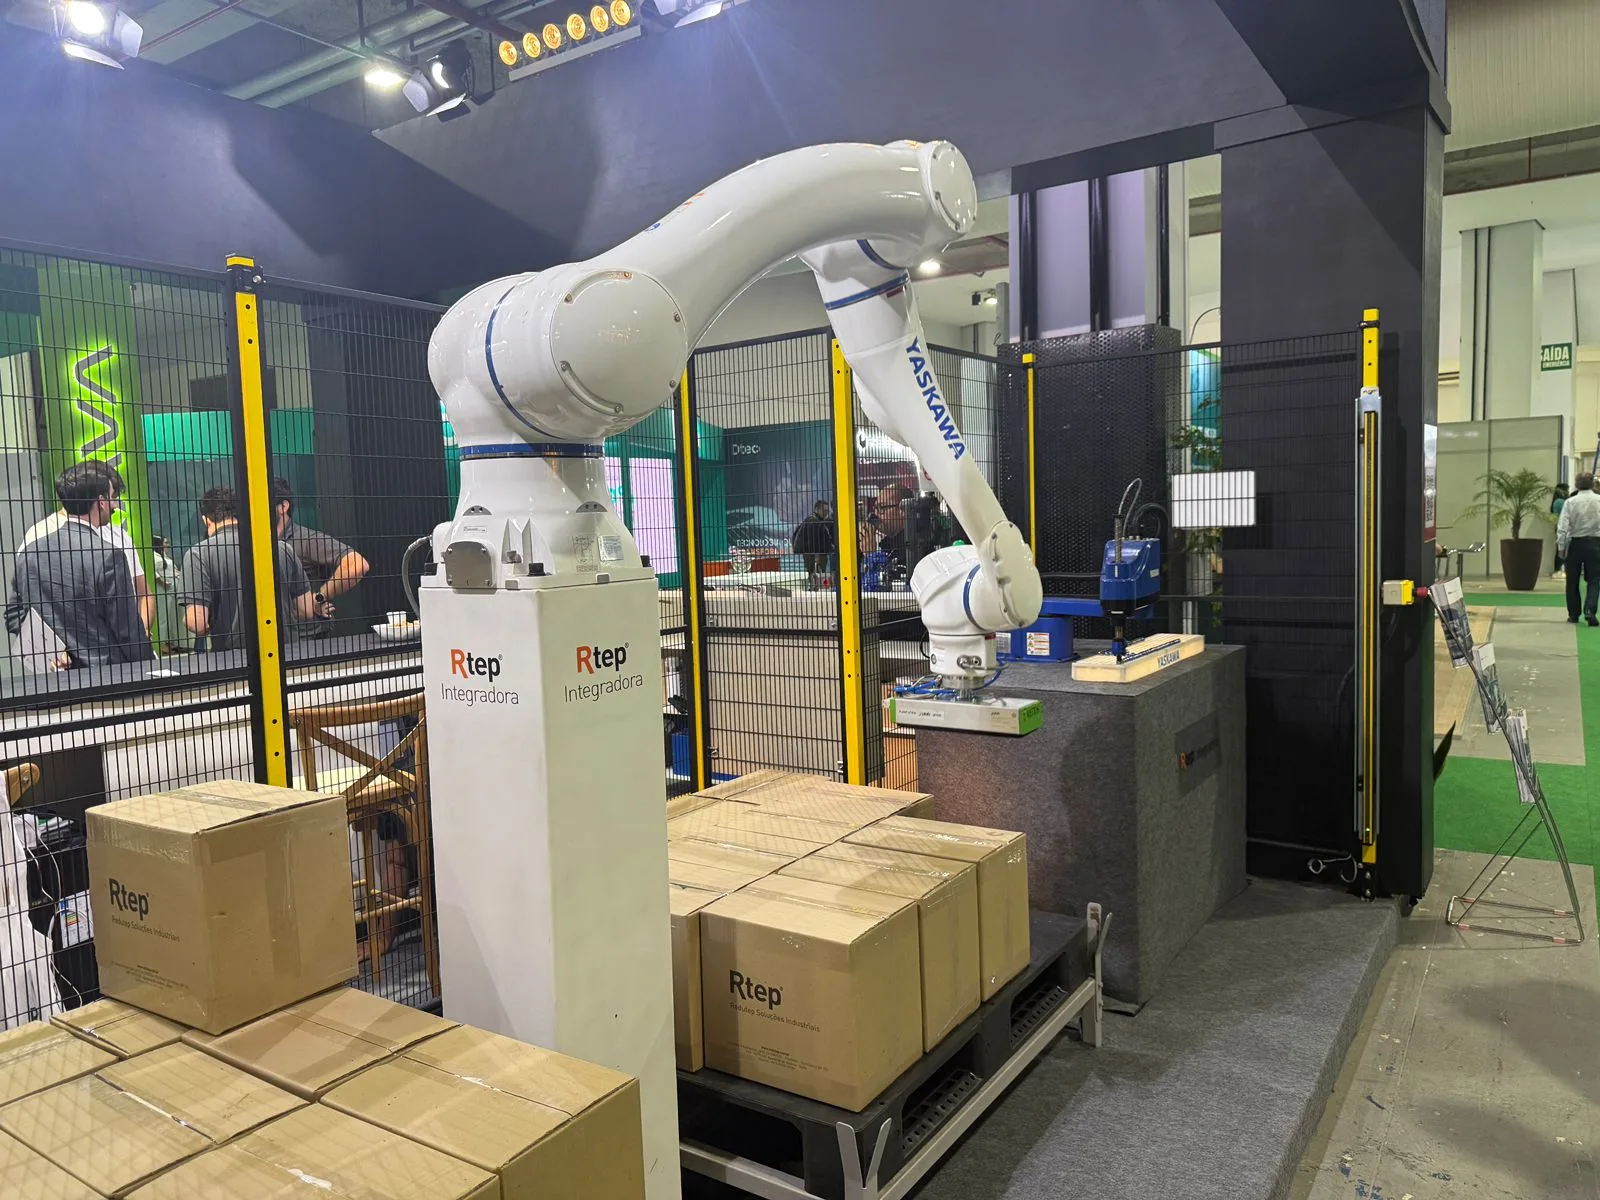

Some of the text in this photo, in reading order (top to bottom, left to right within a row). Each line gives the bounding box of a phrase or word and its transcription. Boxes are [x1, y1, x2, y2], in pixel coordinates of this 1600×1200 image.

[905, 335, 966, 461] YASKAWA
[1157, 649, 1180, 667] YASKAWA
[441, 682, 519, 707] Integradora
[564, 674, 643, 703] Integradora
[729, 1002, 821, 1033] Redutep Soluções Industriais
